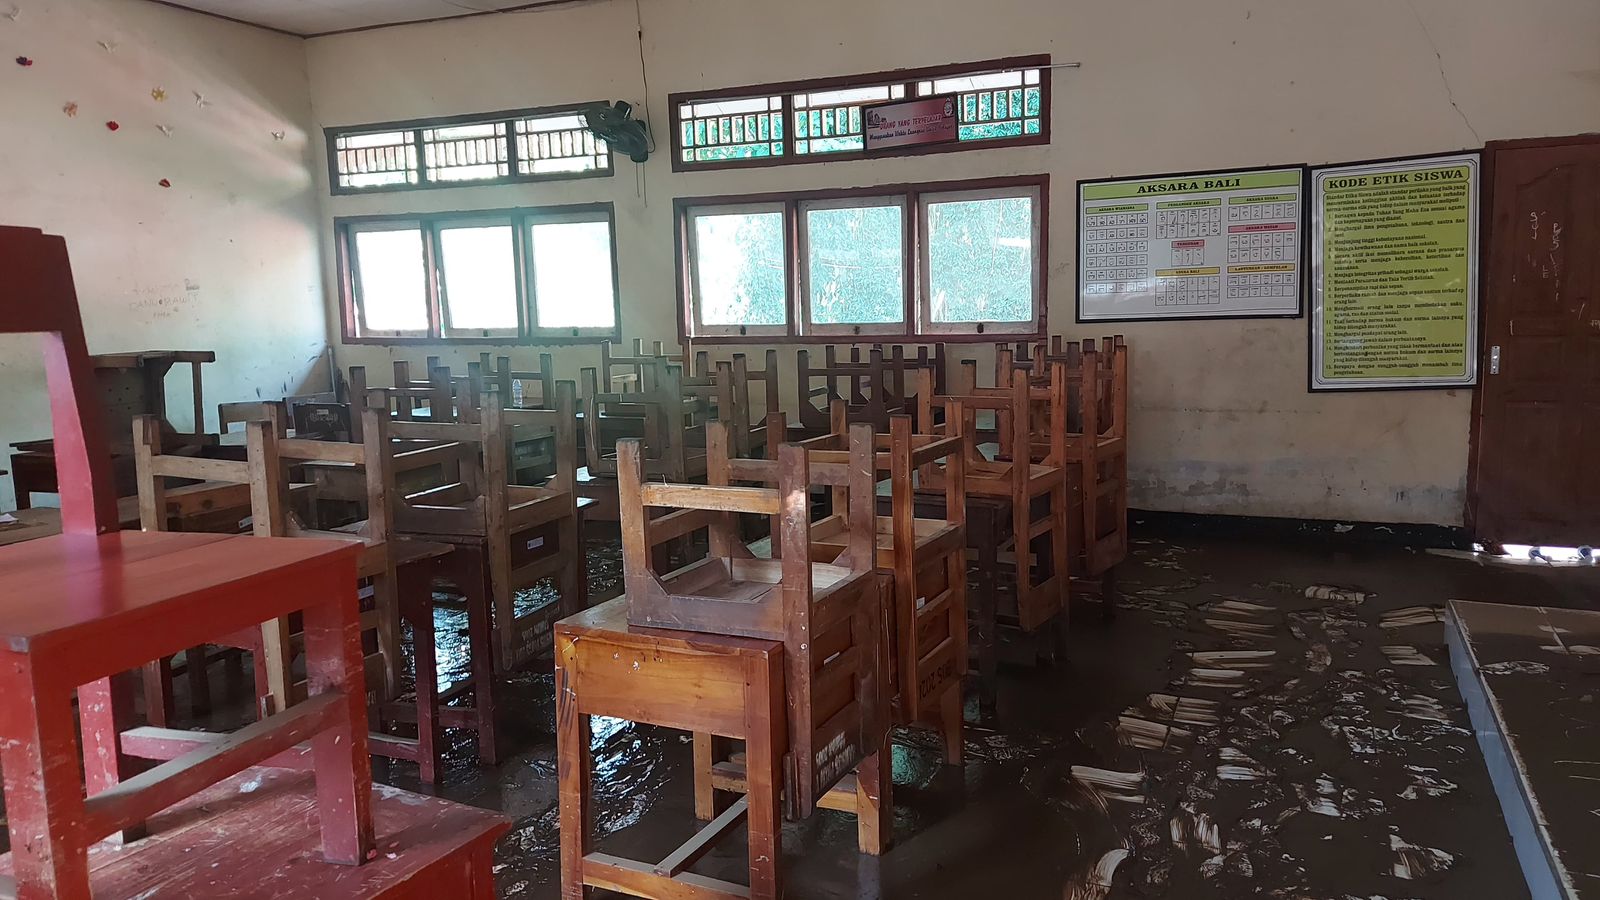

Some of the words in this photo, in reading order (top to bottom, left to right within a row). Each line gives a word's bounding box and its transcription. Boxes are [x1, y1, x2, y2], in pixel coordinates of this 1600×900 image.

[1137, 181, 1199, 194] AKSARA
[1204, 178, 1241, 189] BALI
[1329, 177, 1367, 188] KODE
[1373, 173, 1409, 185] ETIK
[1414, 169, 1463, 182] SISWA
